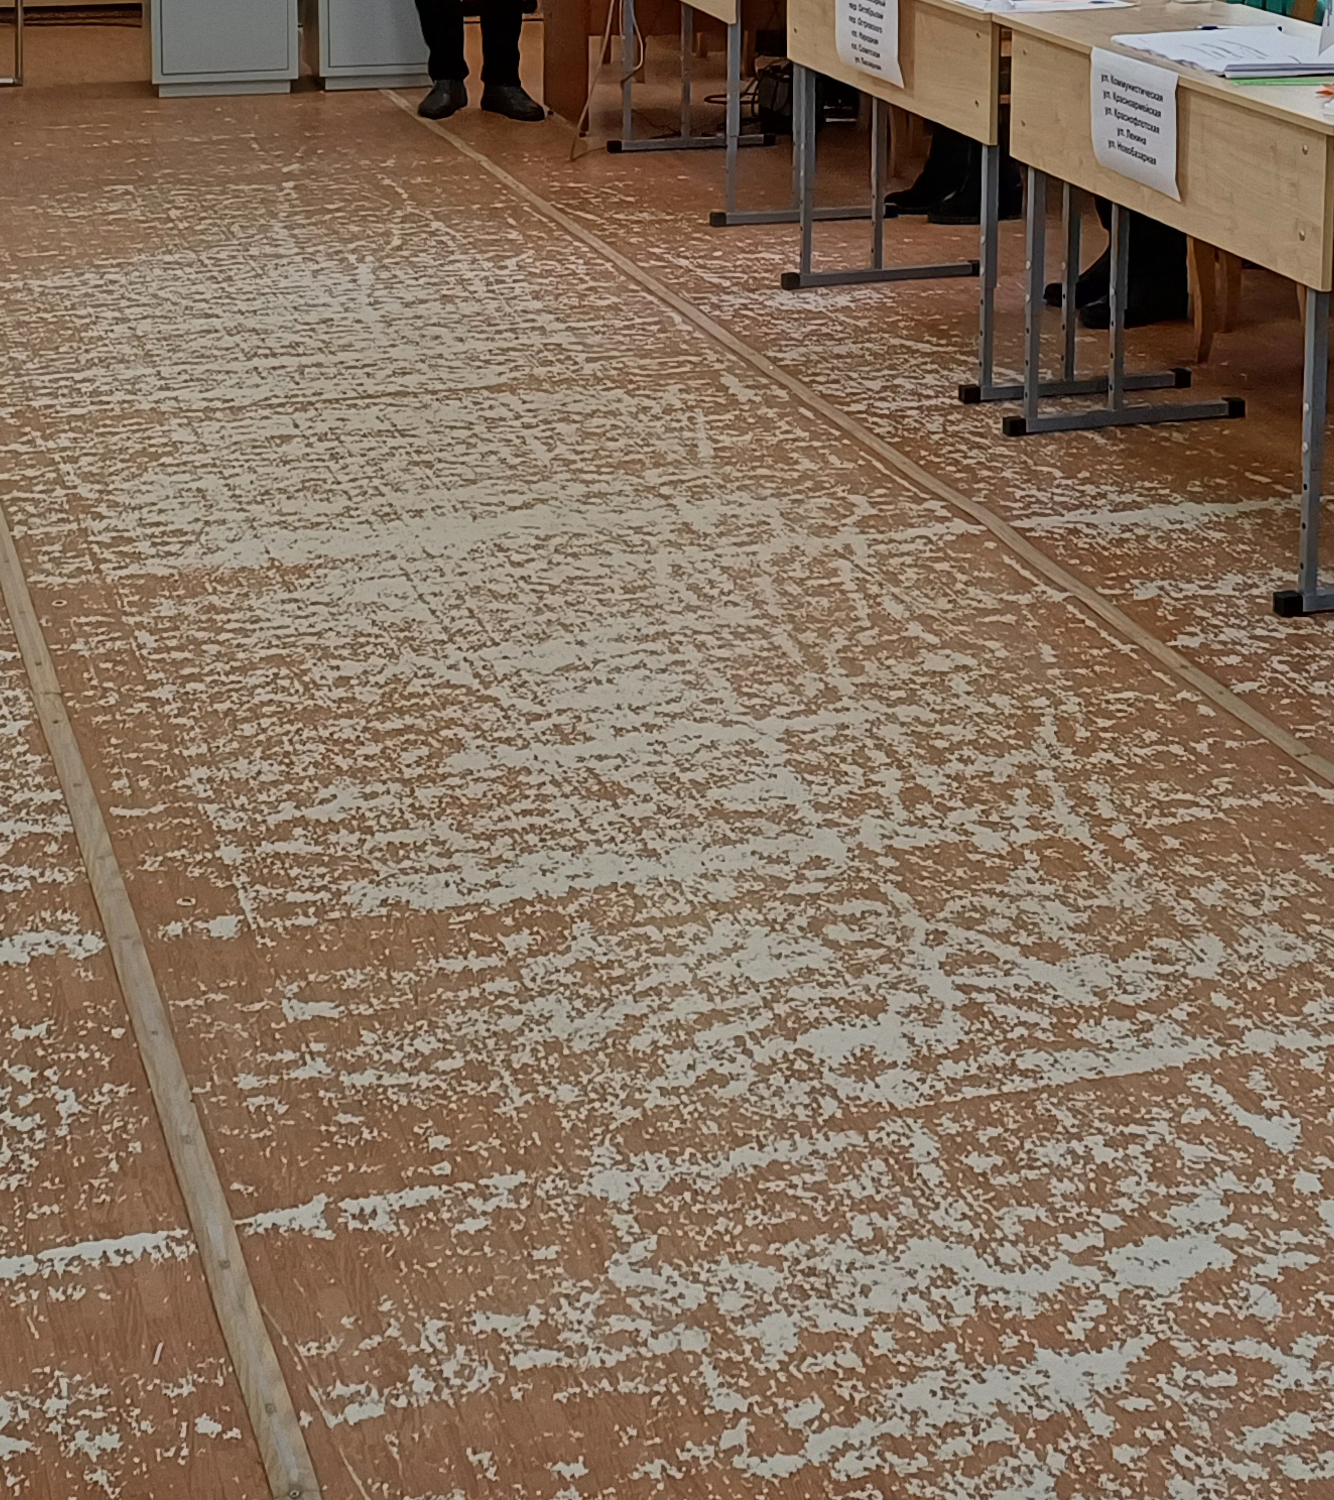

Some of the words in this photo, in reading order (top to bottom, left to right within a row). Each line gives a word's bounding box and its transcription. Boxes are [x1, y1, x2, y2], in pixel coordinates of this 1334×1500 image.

[1101, 74, 1109, 84] ул.
[1111, 75, 1163, 102] Коммунистическая
[1103, 90, 1111, 100] ул.
[1113, 92, 1161, 118] Красноармейская
[1105, 107, 1113, 116] ул.
[1115, 108, 1160, 134] Краснофлотская
[1108, 140, 1116, 148] ул.
[1117, 128, 1125, 137] ул.
[1126, 127, 1147, 145] Ленина
